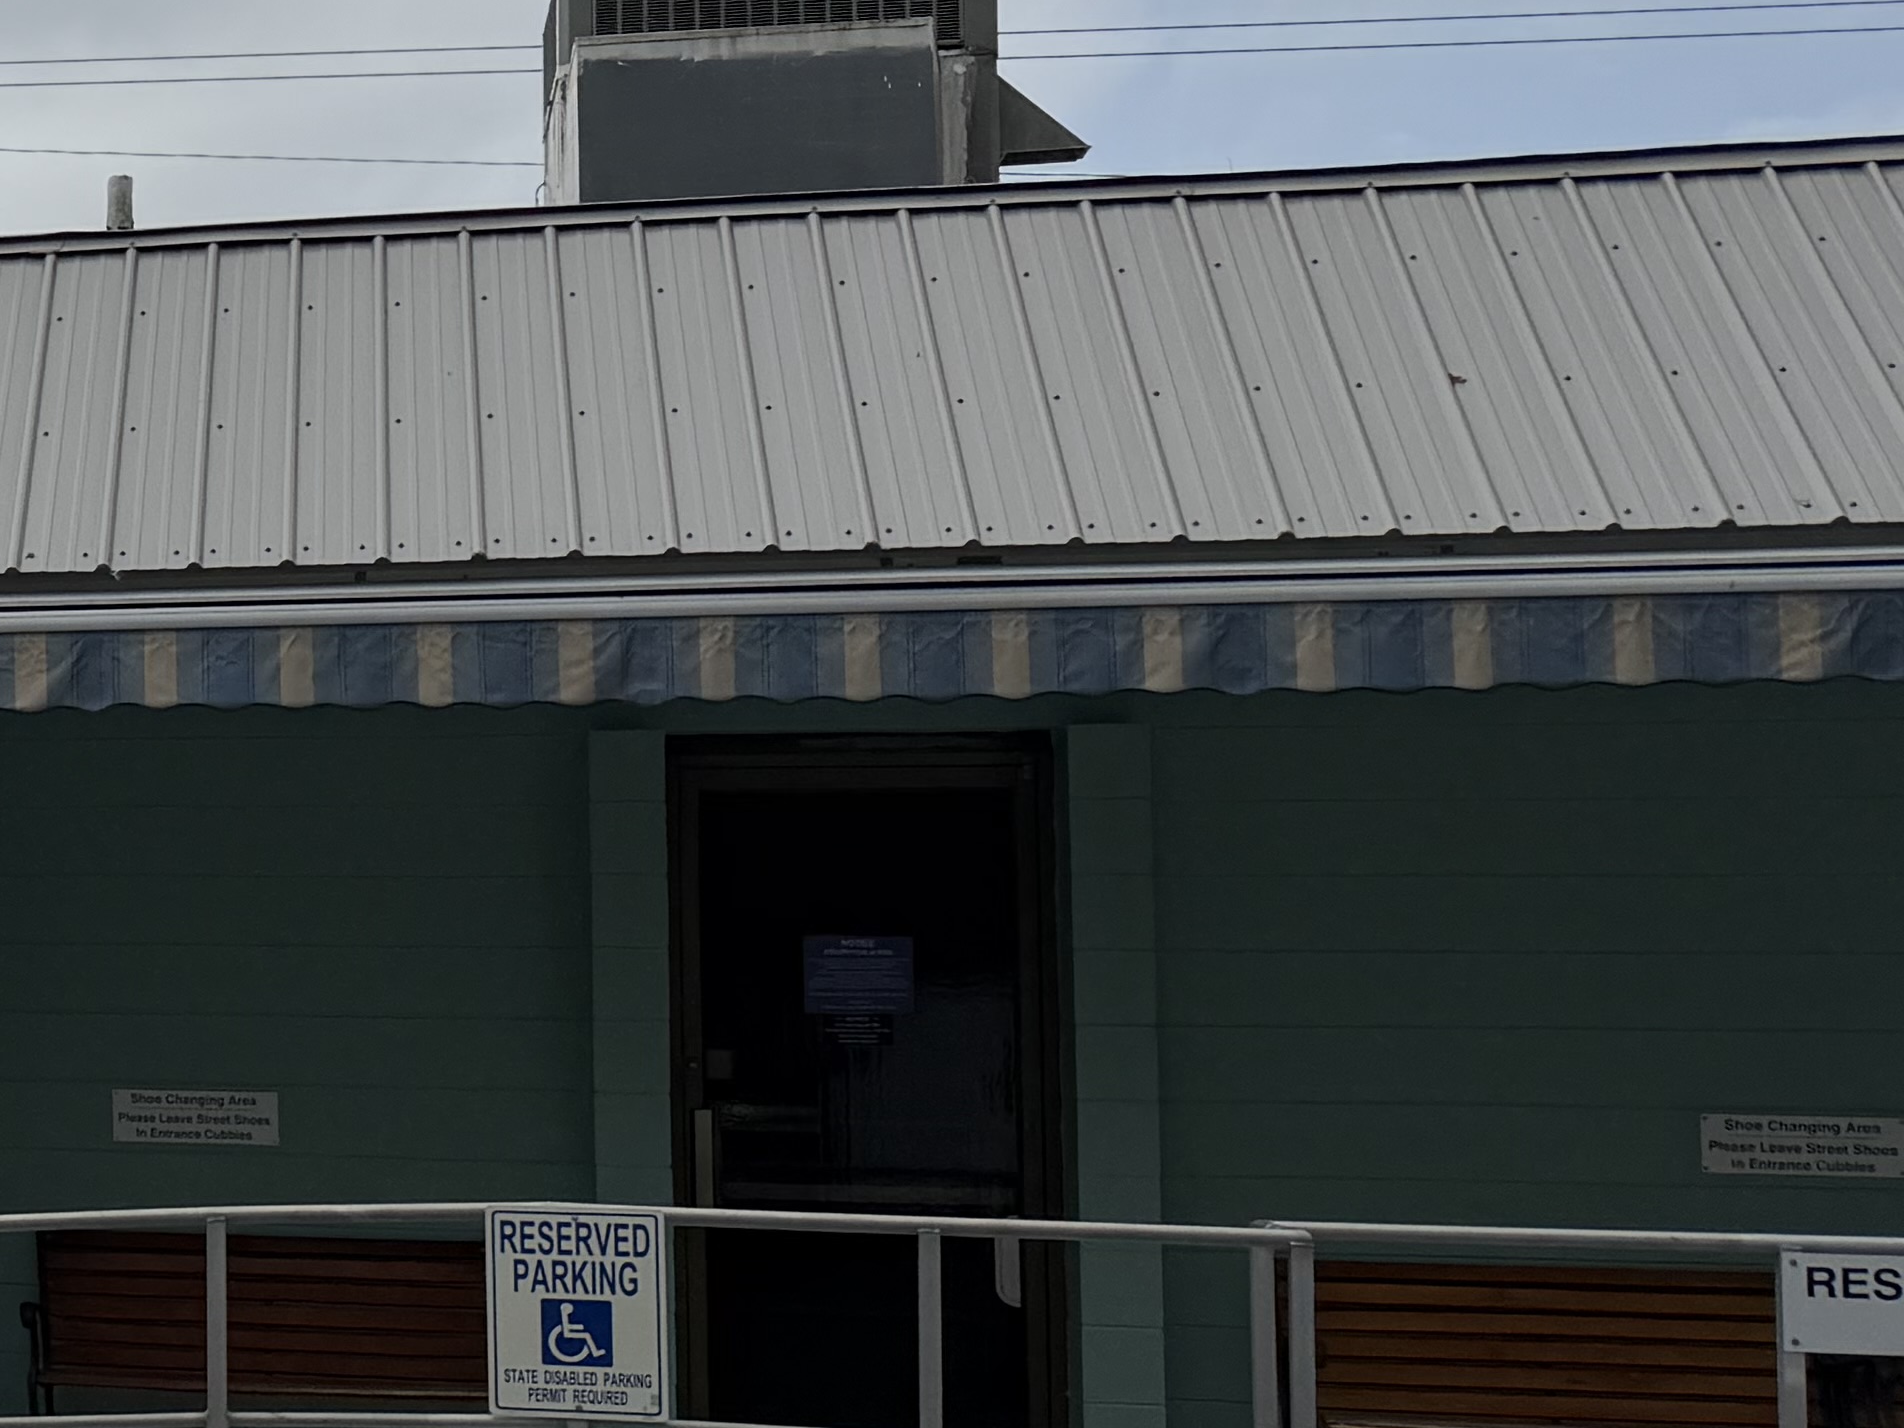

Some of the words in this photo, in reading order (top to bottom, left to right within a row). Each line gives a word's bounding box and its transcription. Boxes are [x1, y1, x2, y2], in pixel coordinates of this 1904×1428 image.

[131, 1093, 161, 1103] Shoe
[165, 1094, 224, 1107] Changing
[228, 1096, 256, 1105] Area
[118, 1112, 155, 1123] Please
[160, 1114, 192, 1123] Leave
[197, 1114, 230, 1124] Street
[234, 1115, 270, 1125] Shoes
[151, 1128, 201, 1138] Entrance
[205, 1130, 252, 1140] Cubbies
[1724, 1119, 1763, 1131] Shoe
[1768, 1120, 1841, 1135] Changing
[1846, 1122, 1881, 1133] Area
[1709, 1140, 1755, 1151] Please
[1760, 1142, 1801, 1153] Leave
[1806, 1143, 1849, 1154] Street
[1853, 1144, 1898, 1156] Shoes
[1749, 1158, 1811, 1170] Entrance
[1817, 1160, 1876, 1172] Cubbies
[500, 1220, 650, 1258] RESERVED
[513, 1259, 638, 1296] PARKING
[1806, 1266, 1903, 1301] RES
[504, 1369, 538, 1384] STATE
[544, 1370, 598, 1386] DISABLED
[604, 1372, 652, 1388] PARKING
[528, 1388, 567, 1402] PERMIT
[573, 1389, 628, 1405] REQUIRED
